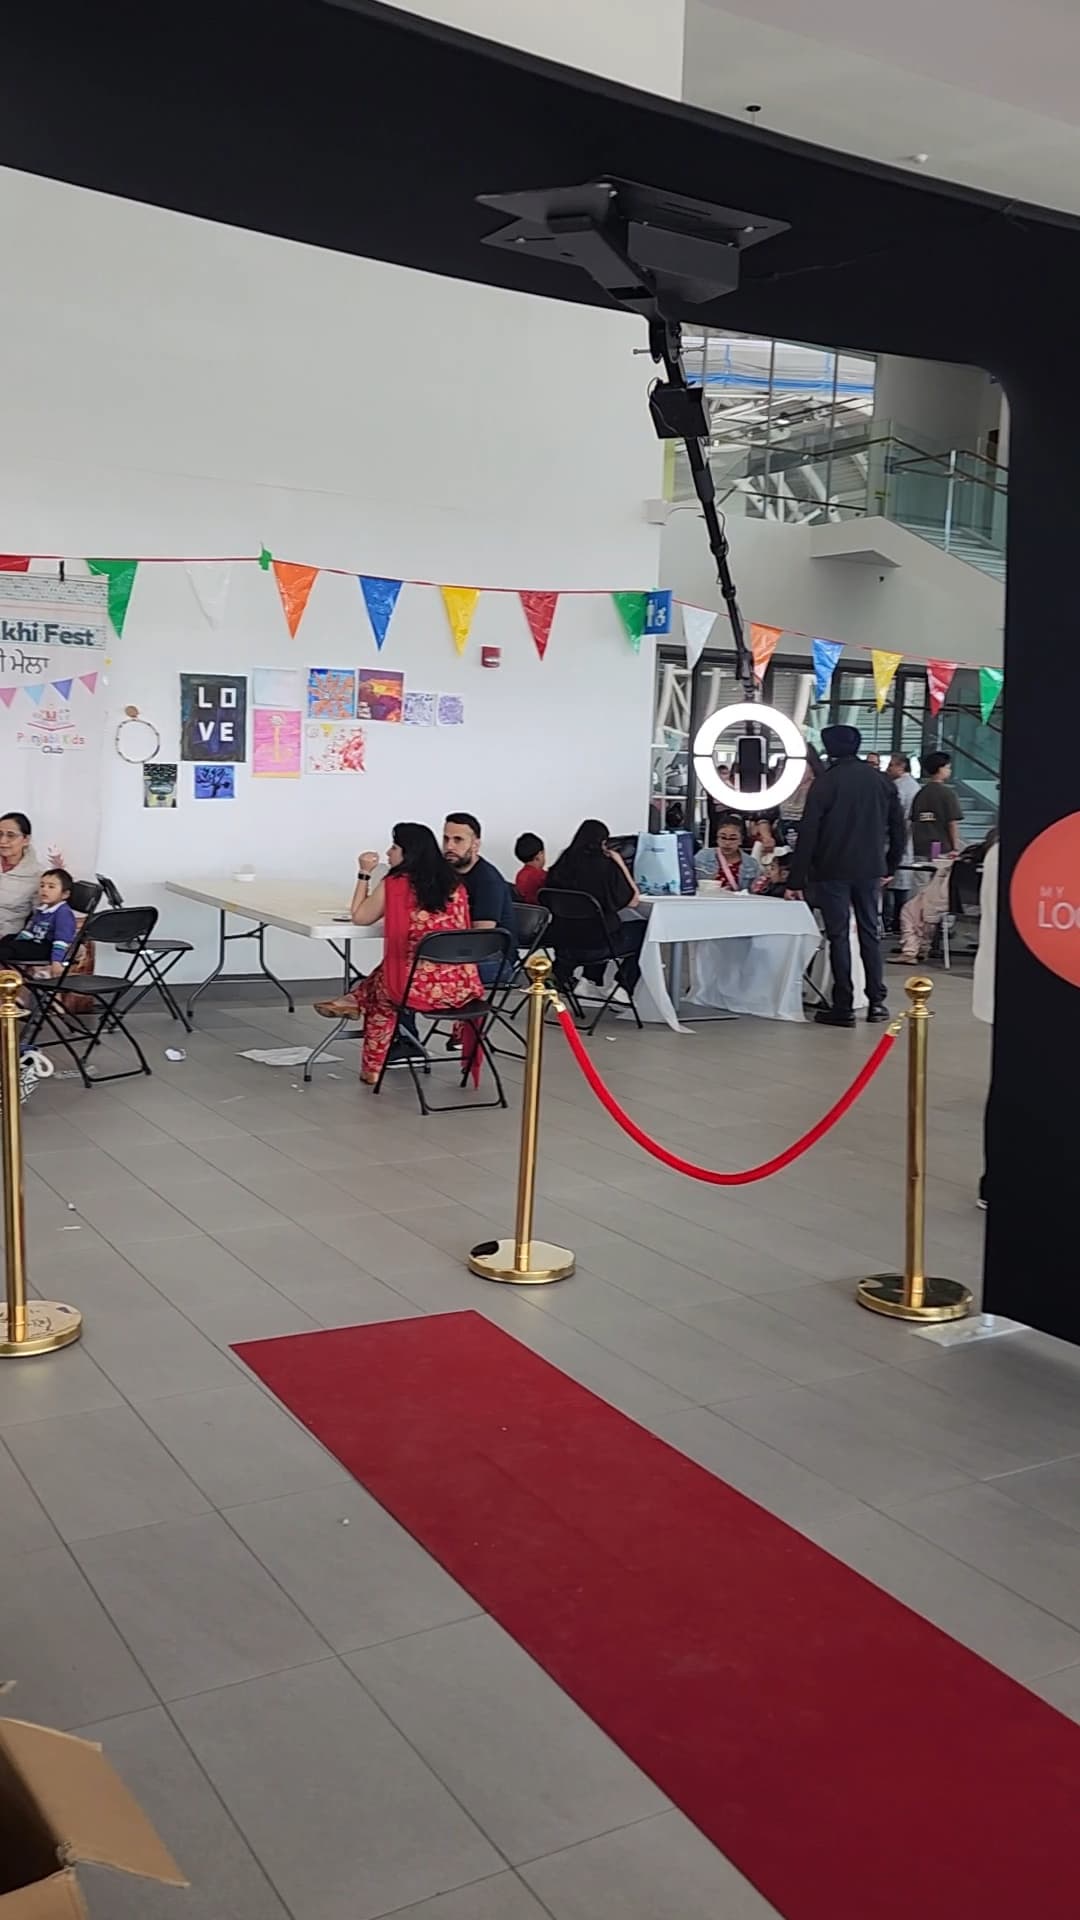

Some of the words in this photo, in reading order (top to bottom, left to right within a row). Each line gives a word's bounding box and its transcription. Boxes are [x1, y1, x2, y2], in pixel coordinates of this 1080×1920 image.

[1, 620, 39, 642] khi
[43, 623, 95, 646] Fest
[16, 732, 58, 747] Pnjab
[63, 735, 86, 745] Kds
[1038, 900, 1080, 930] LO
